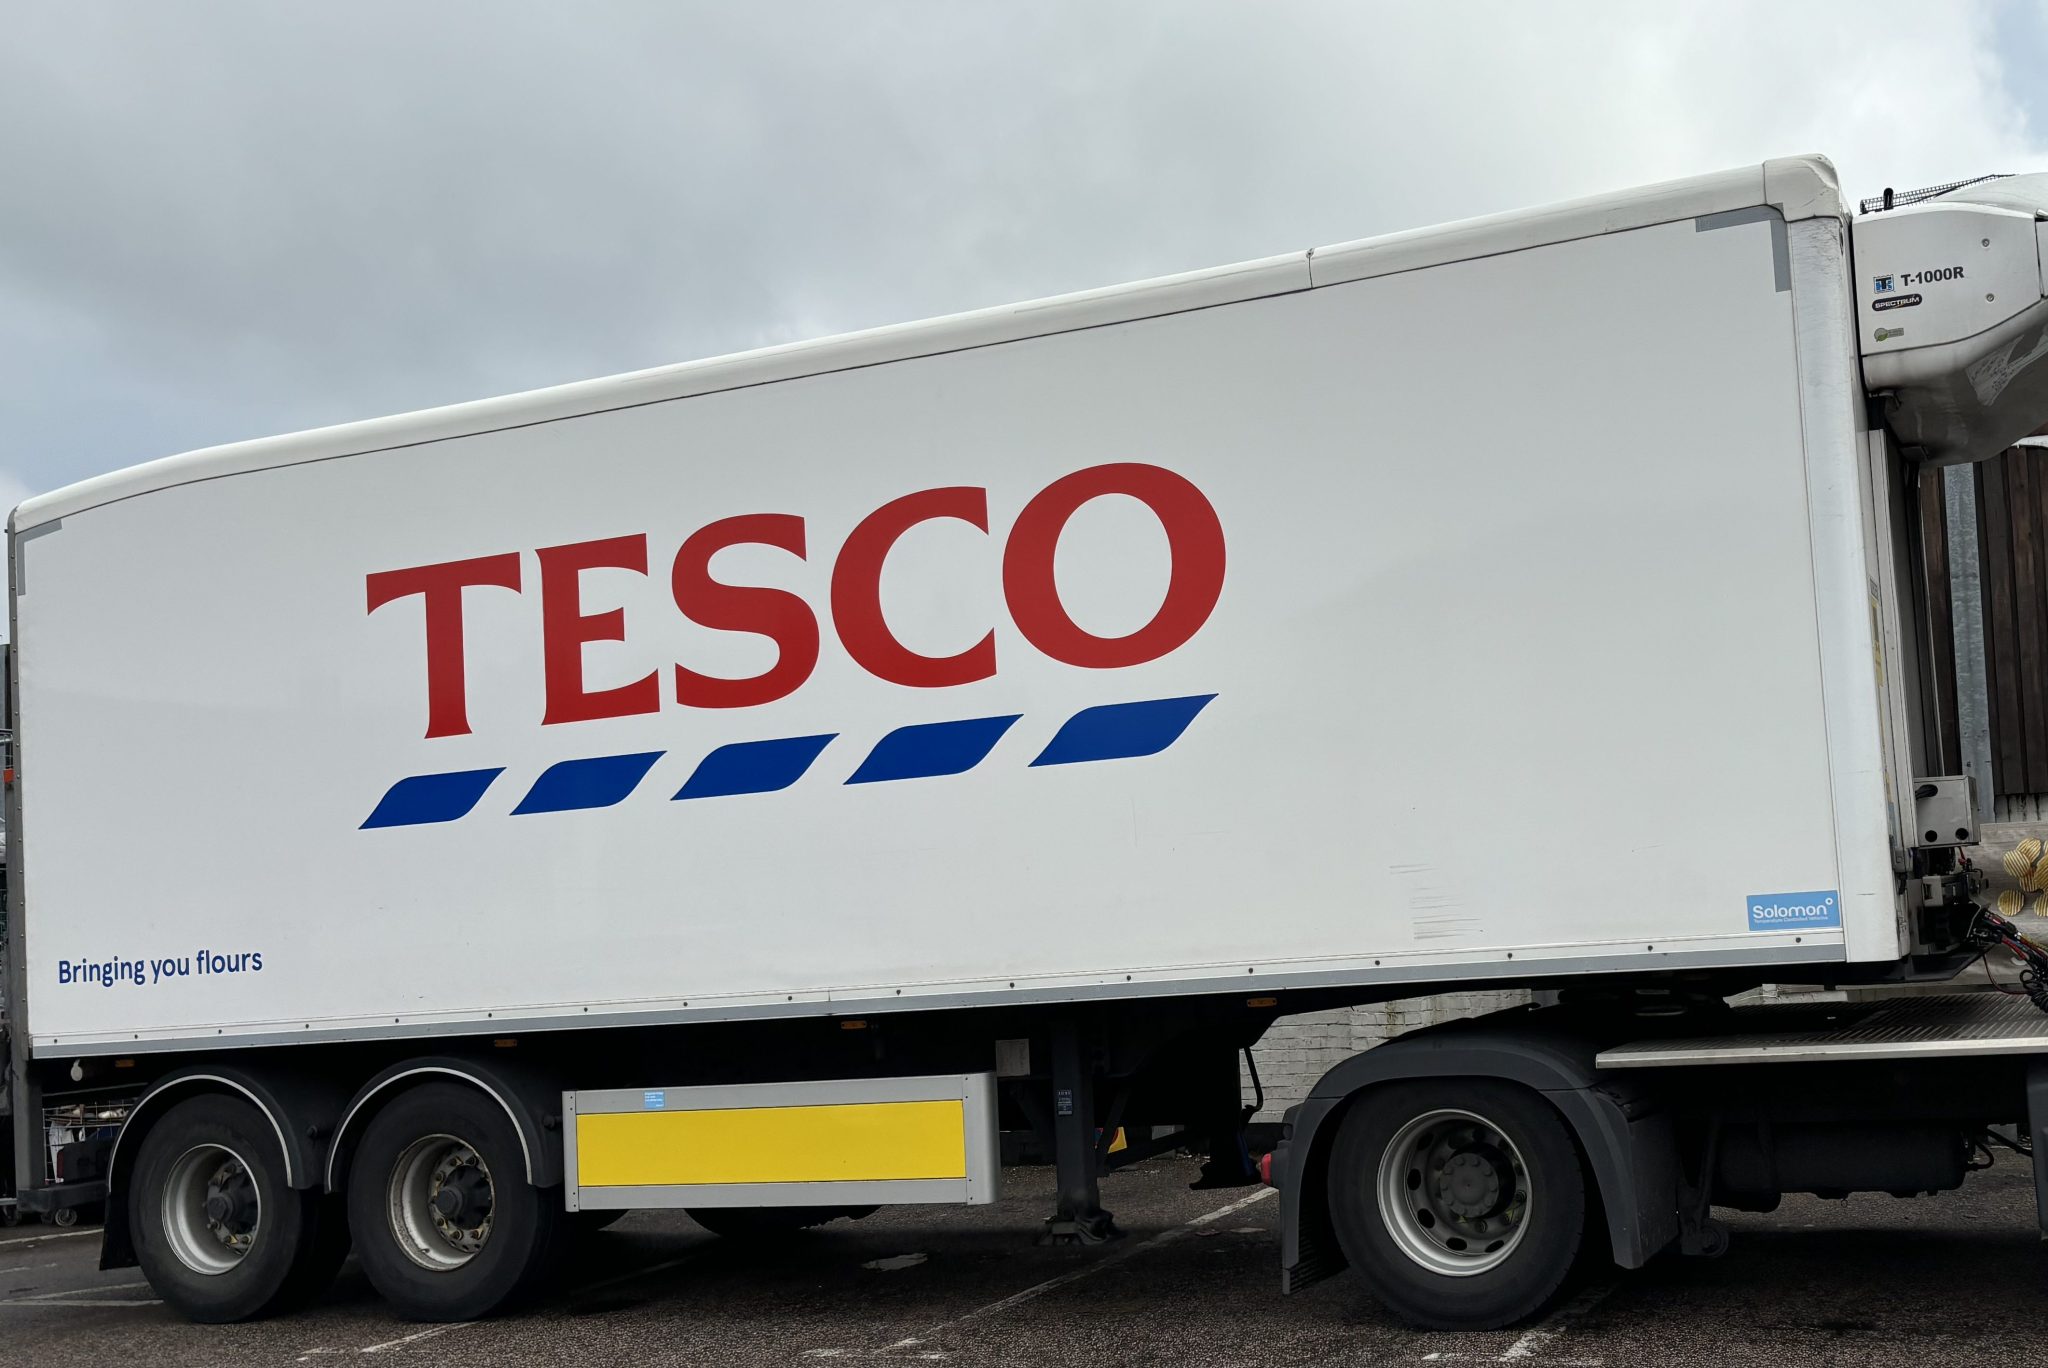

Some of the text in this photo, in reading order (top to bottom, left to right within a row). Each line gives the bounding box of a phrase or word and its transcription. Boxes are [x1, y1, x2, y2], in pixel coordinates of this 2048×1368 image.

[1900, 266, 1965, 287] T-1000R
[1874, 296, 1920, 309] SPECTRUM
[367, 463, 1227, 738] TESCO
[58, 948, 264, 988] Bringing you flours
